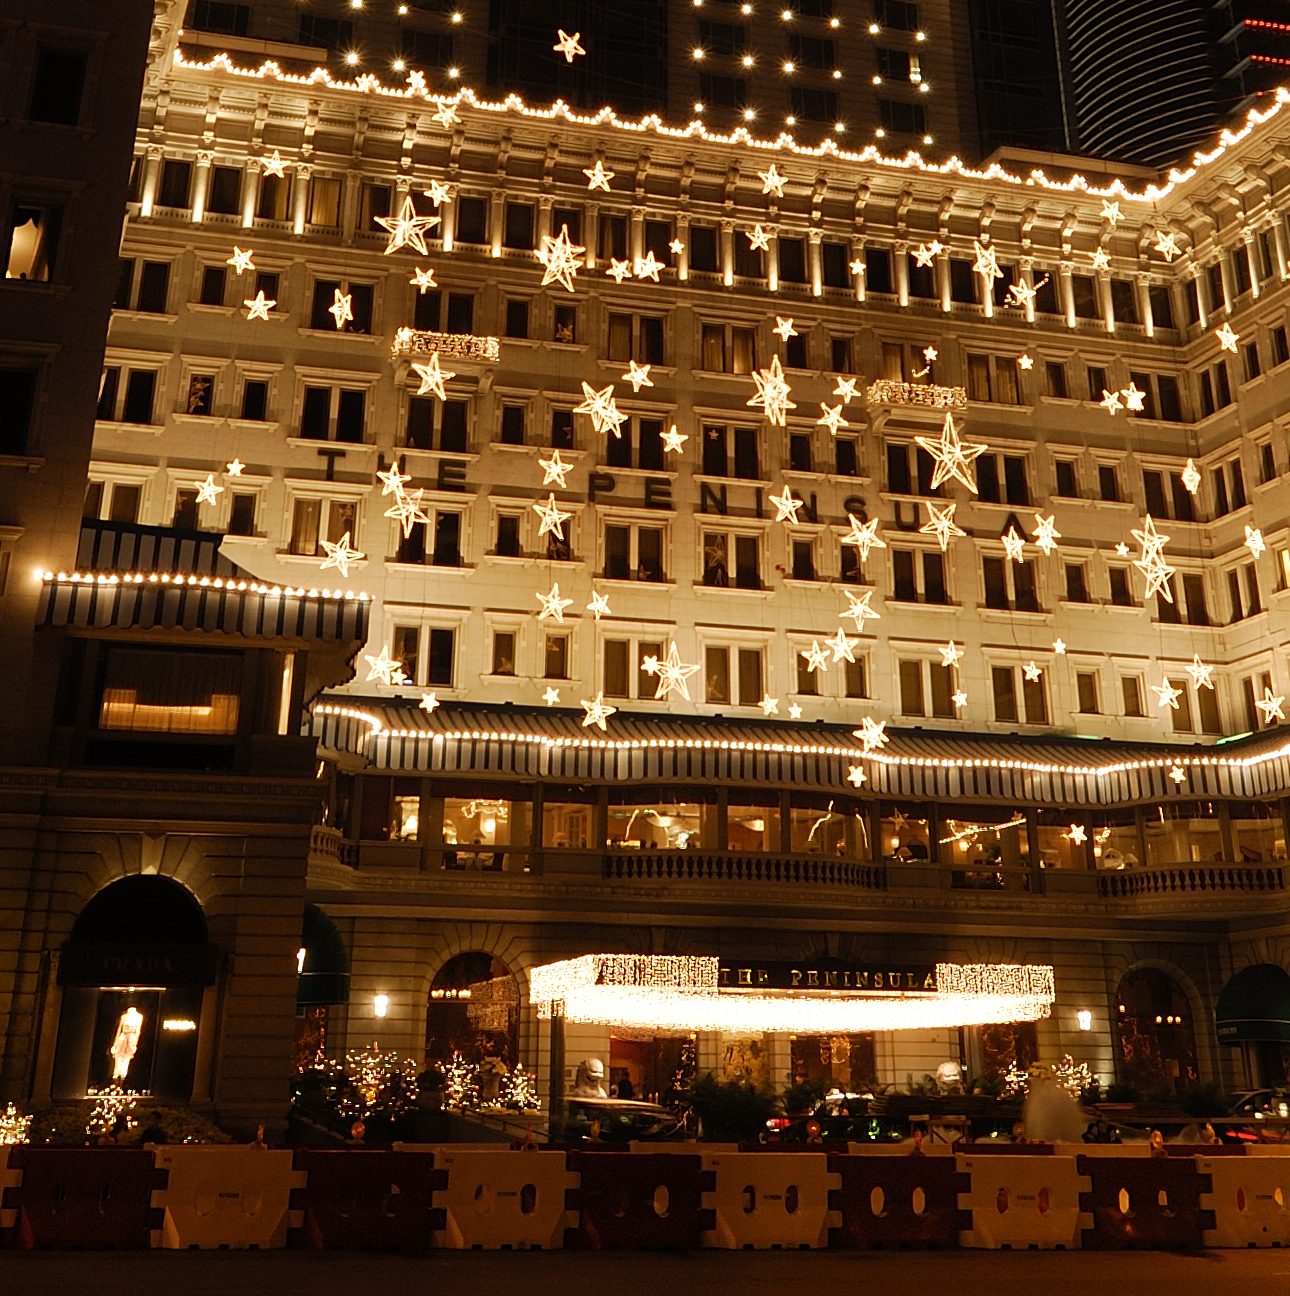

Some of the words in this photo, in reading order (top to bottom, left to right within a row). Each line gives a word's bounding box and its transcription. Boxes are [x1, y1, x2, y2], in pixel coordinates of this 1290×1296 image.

[318, 448, 466, 492] THE
[588, 473, 1030, 543] PENINSUA
[720, 968, 769, 985] THE
[790, 969, 936, 989] PENINSULA
